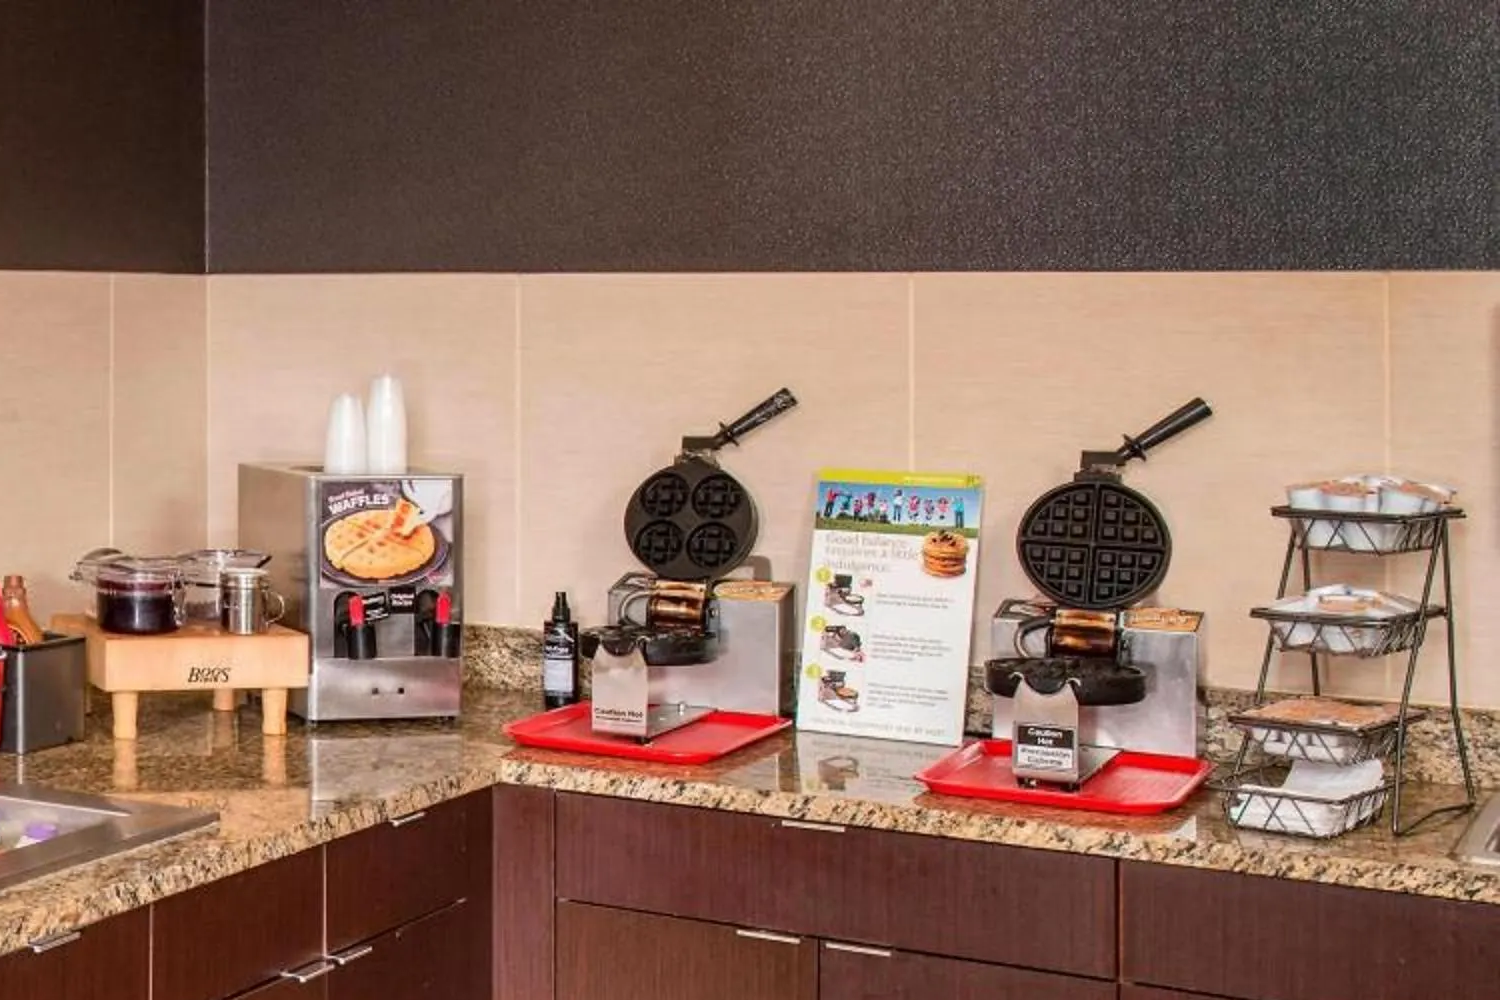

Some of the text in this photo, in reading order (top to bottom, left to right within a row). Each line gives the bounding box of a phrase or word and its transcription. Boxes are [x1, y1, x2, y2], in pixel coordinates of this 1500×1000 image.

[328, 494, 389, 514] WAFFLES
[594, 707, 643, 718] Caution Hot
[1027, 727, 1063, 739] Caution
[1037, 737, 1053, 746] Hot
